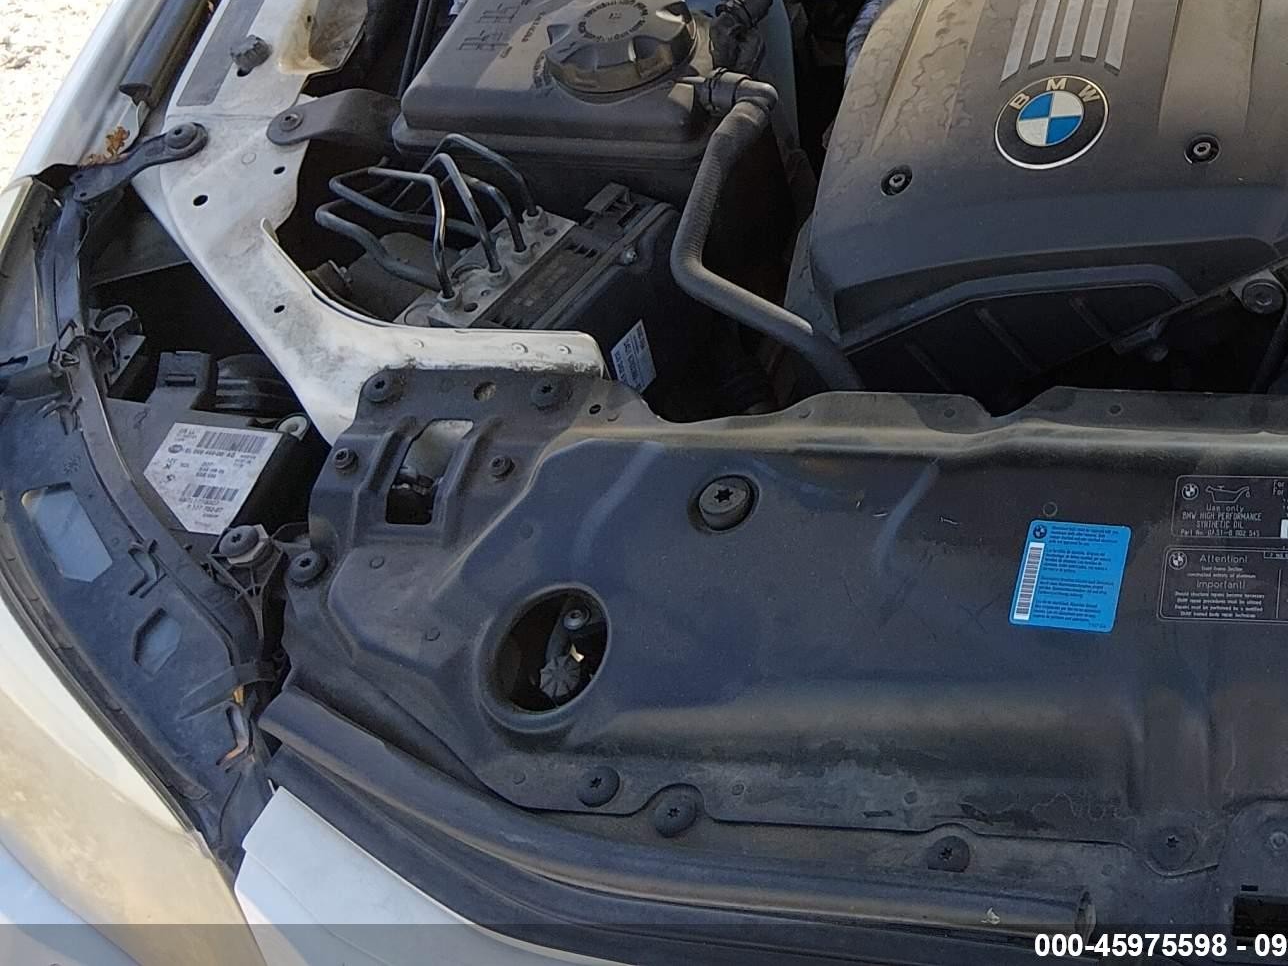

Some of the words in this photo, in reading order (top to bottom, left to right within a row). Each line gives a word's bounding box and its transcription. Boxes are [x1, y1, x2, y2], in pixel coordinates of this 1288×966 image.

[1009, 77, 1101, 110] BMW
[1226, 504, 1245, 513] only
[1200, 512, 1215, 520] HIGH
[1218, 512, 1262, 522] PERFORMANCE
[1196, 520, 1230, 530] SYNTHETIC
[1234, 521, 1244, 530] OIL
[1200, 554, 1248, 563] Attention!
[1196, 580, 1246, 590] Important!
